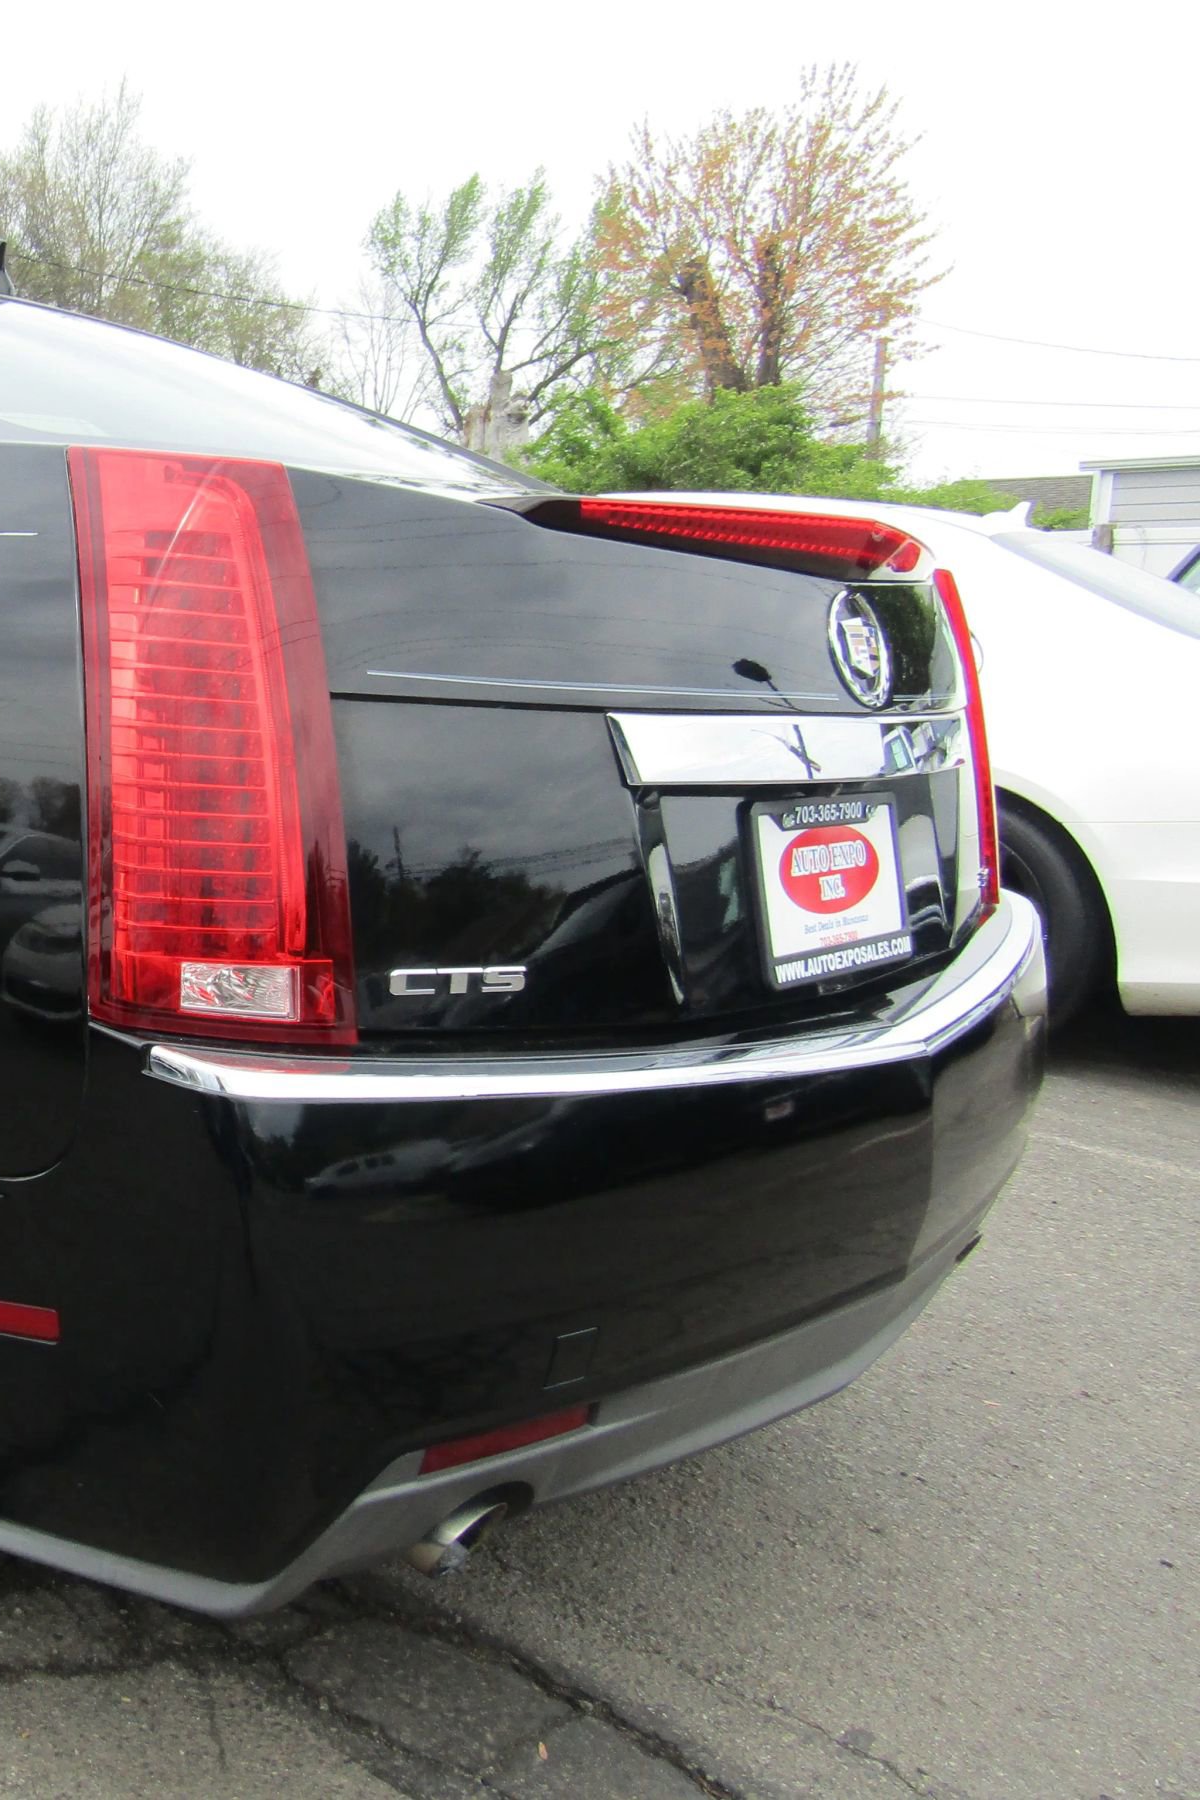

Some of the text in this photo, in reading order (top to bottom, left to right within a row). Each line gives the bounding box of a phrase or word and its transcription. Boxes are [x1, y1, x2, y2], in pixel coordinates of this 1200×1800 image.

[794, 801, 862, 824] 703-365-7900
[792, 841, 866, 875] AUTO EXPO
[819, 876, 845, 900] INC.
[775, 936, 912, 984] WWW.AUTOEXPOSALES.COM
[389, 965, 527, 996] CTS
